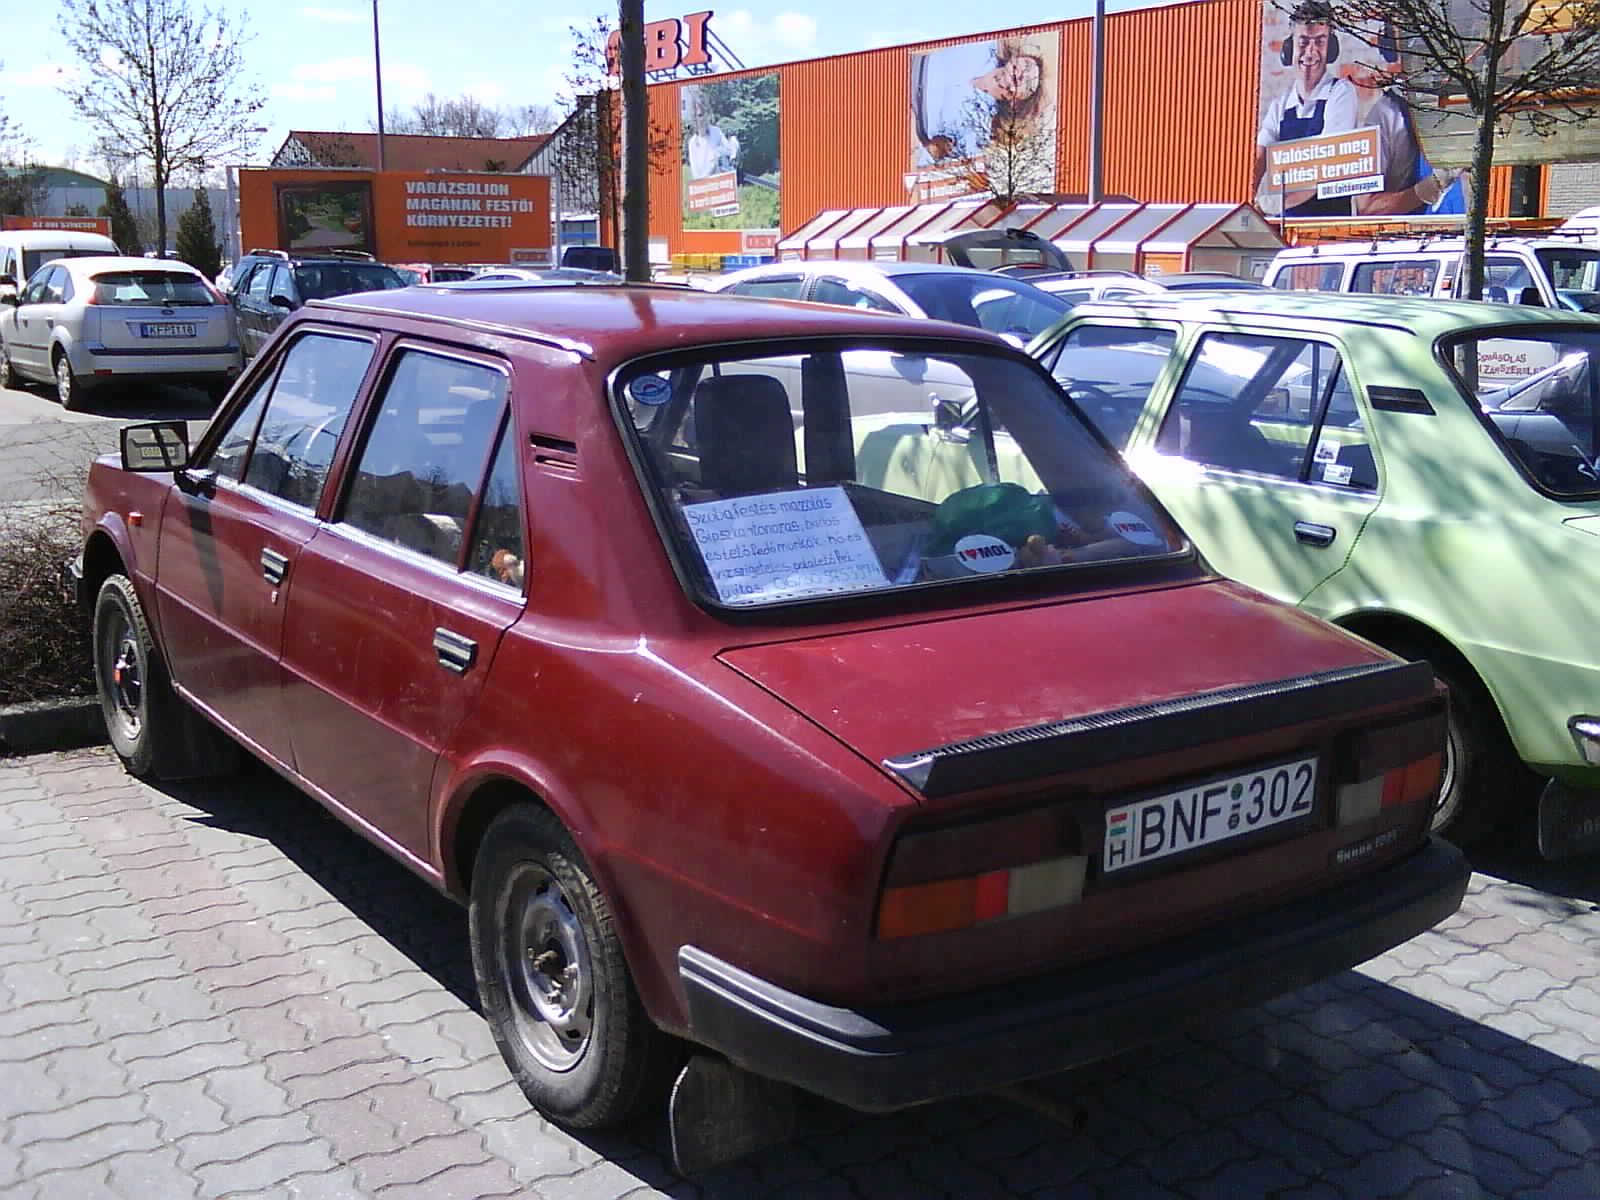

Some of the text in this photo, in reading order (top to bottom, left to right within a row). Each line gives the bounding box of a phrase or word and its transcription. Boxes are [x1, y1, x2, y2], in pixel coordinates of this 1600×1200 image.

[1339, 138, 1371, 155] meg
[1321, 156, 1374, 178] terveit!
[958, 544, 1011, 562] I MOL
[1108, 840, 1127, 867] H
